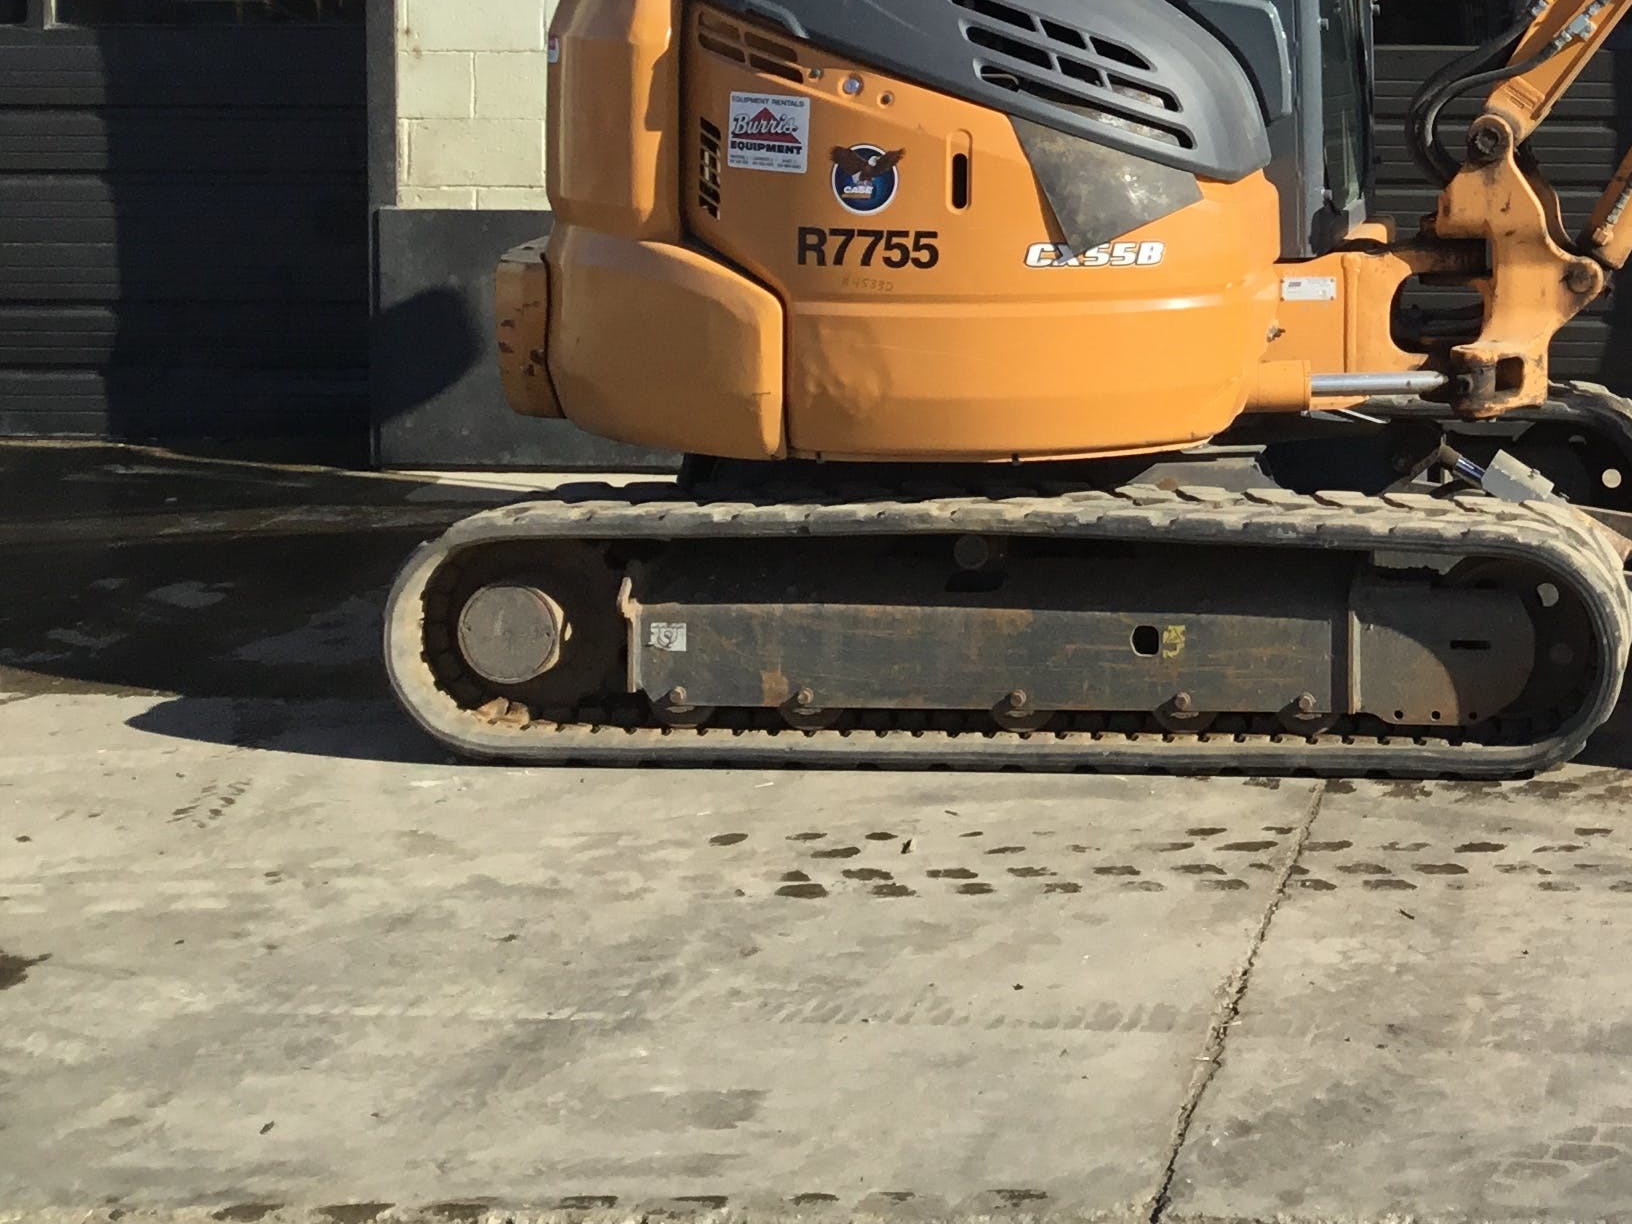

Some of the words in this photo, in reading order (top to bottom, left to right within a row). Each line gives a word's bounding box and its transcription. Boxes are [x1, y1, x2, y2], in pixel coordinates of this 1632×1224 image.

[732, 95, 769, 105] EQUIPMENT
[772, 98, 805, 107] RENTALS
[731, 113, 799, 135] Burris
[730, 140, 803, 155] EQUIPMENT
[797, 226, 939, 269] R7755
